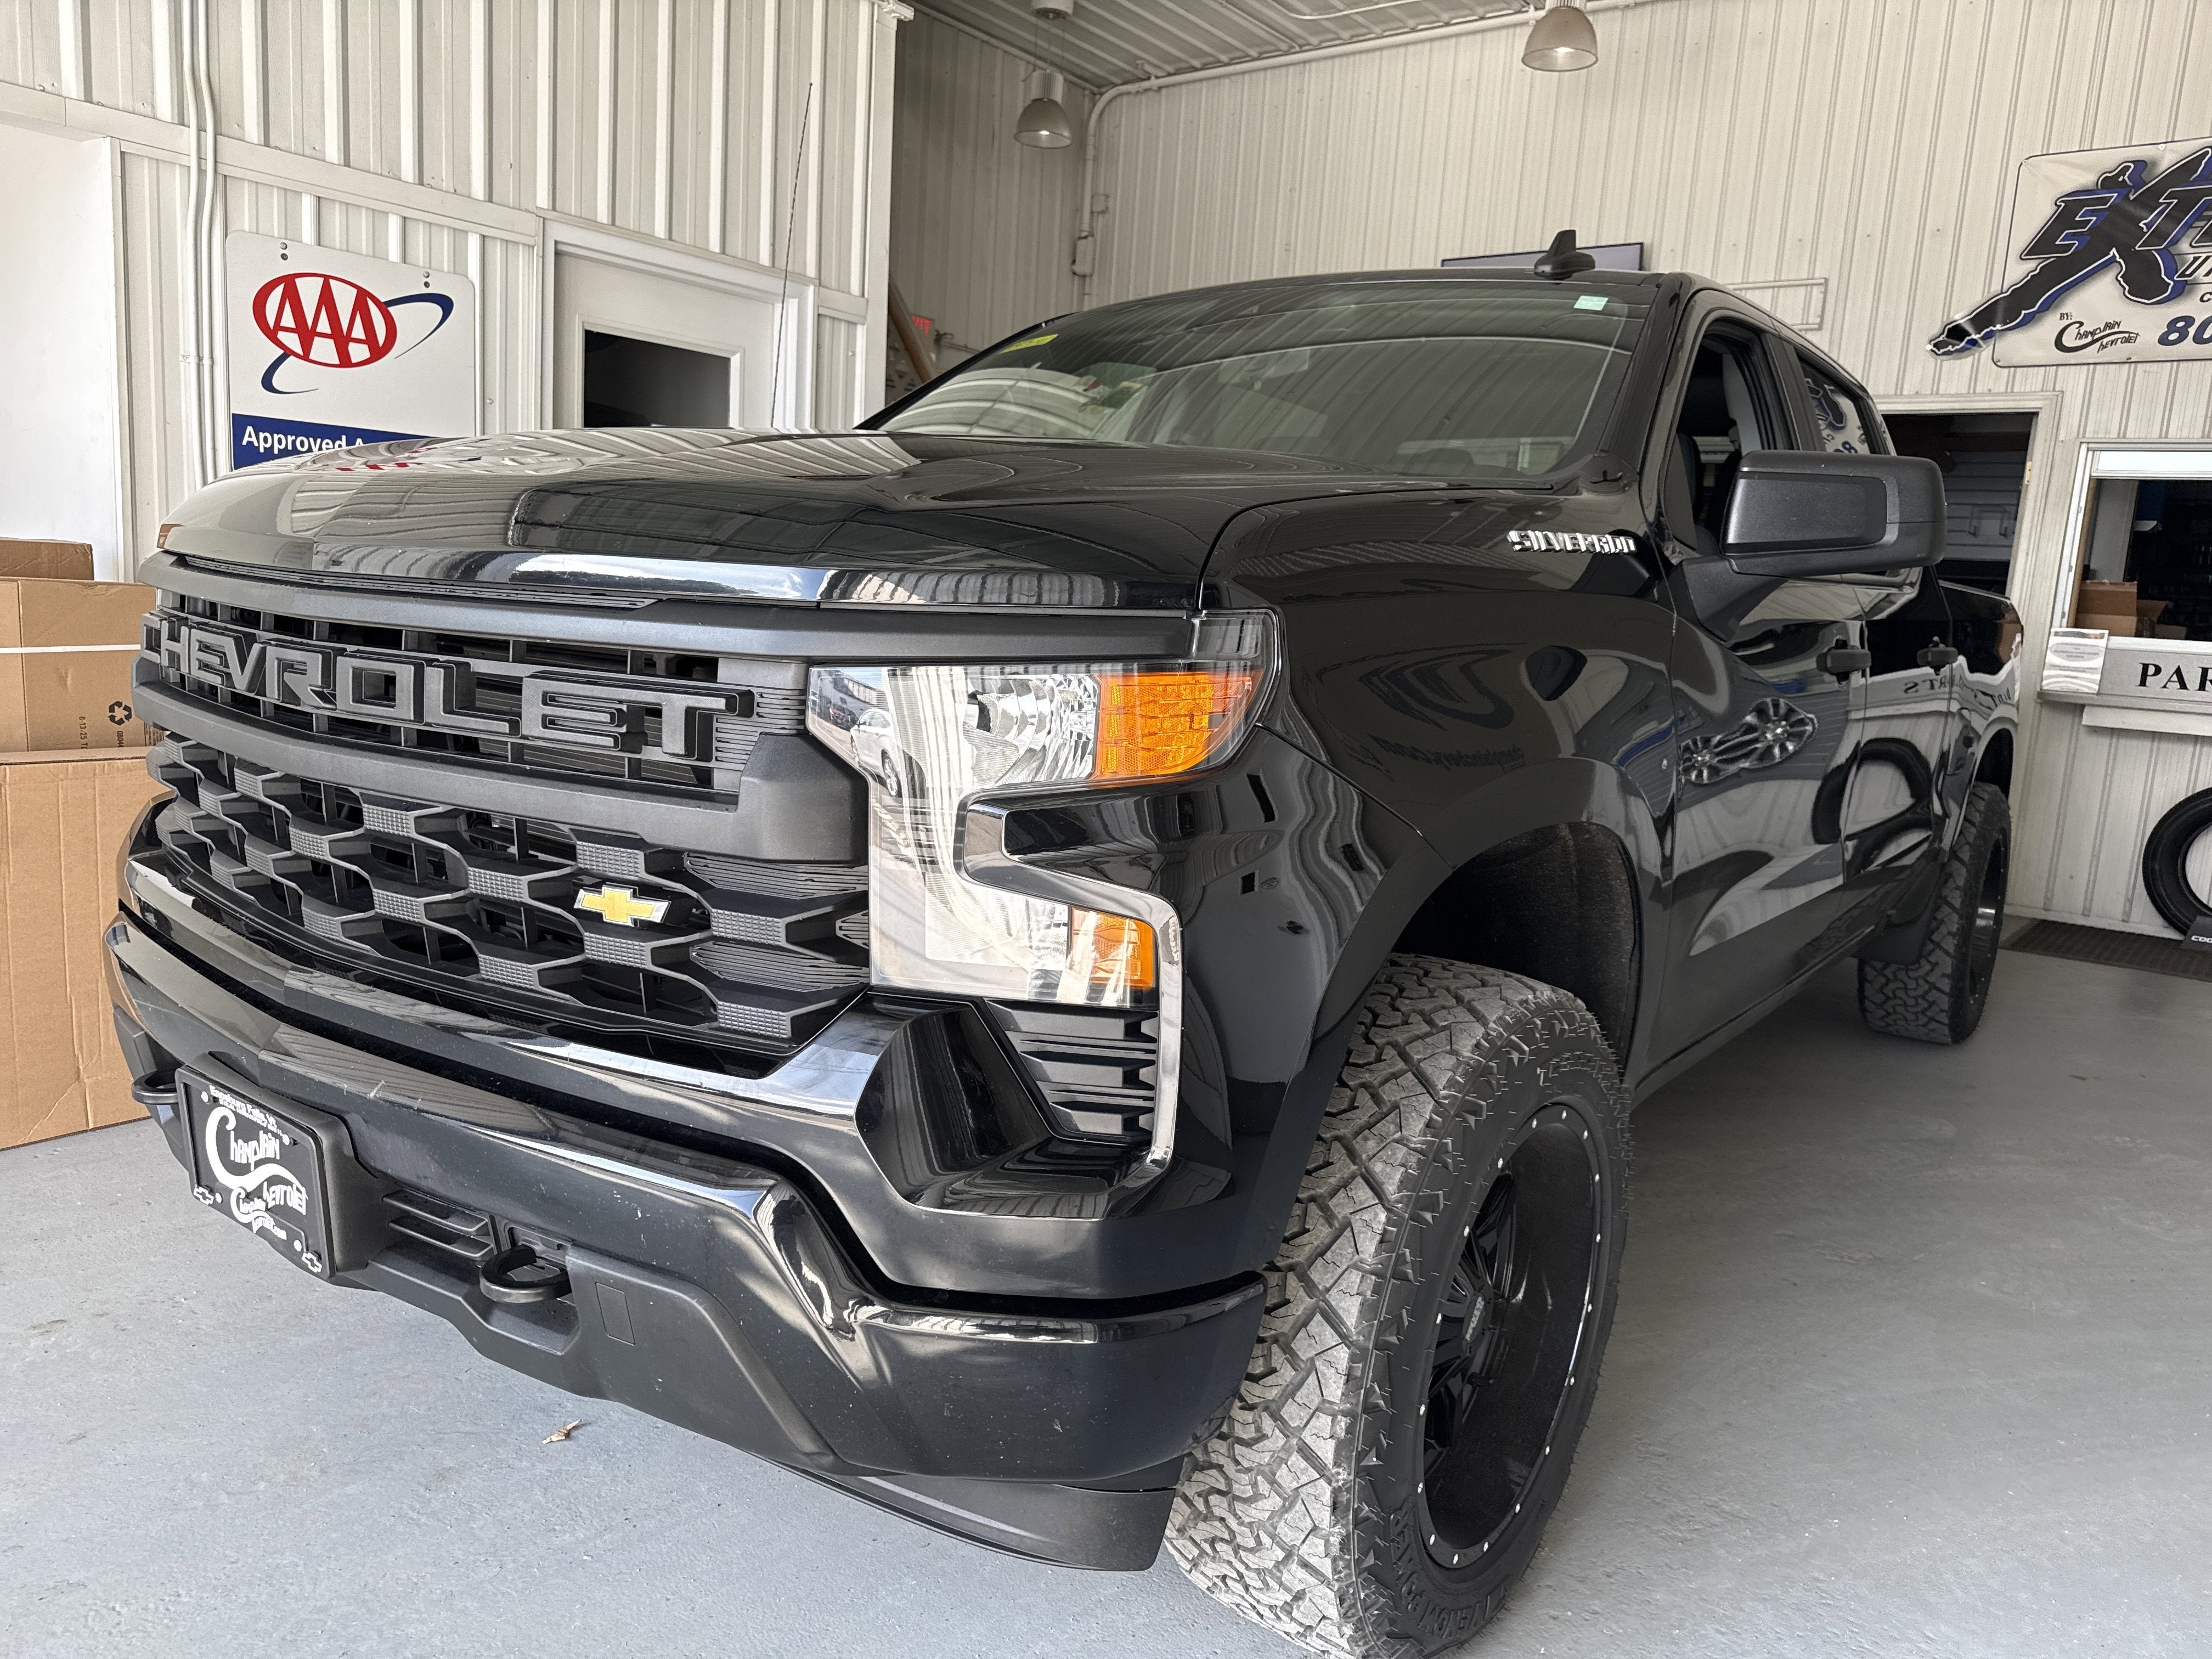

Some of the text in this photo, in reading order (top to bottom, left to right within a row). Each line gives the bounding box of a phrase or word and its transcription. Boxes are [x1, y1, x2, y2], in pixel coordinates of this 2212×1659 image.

[262, 273, 391, 368] AAA
[242, 426, 346, 455] Approved
[140, 611, 751, 761] CHEVROLET
